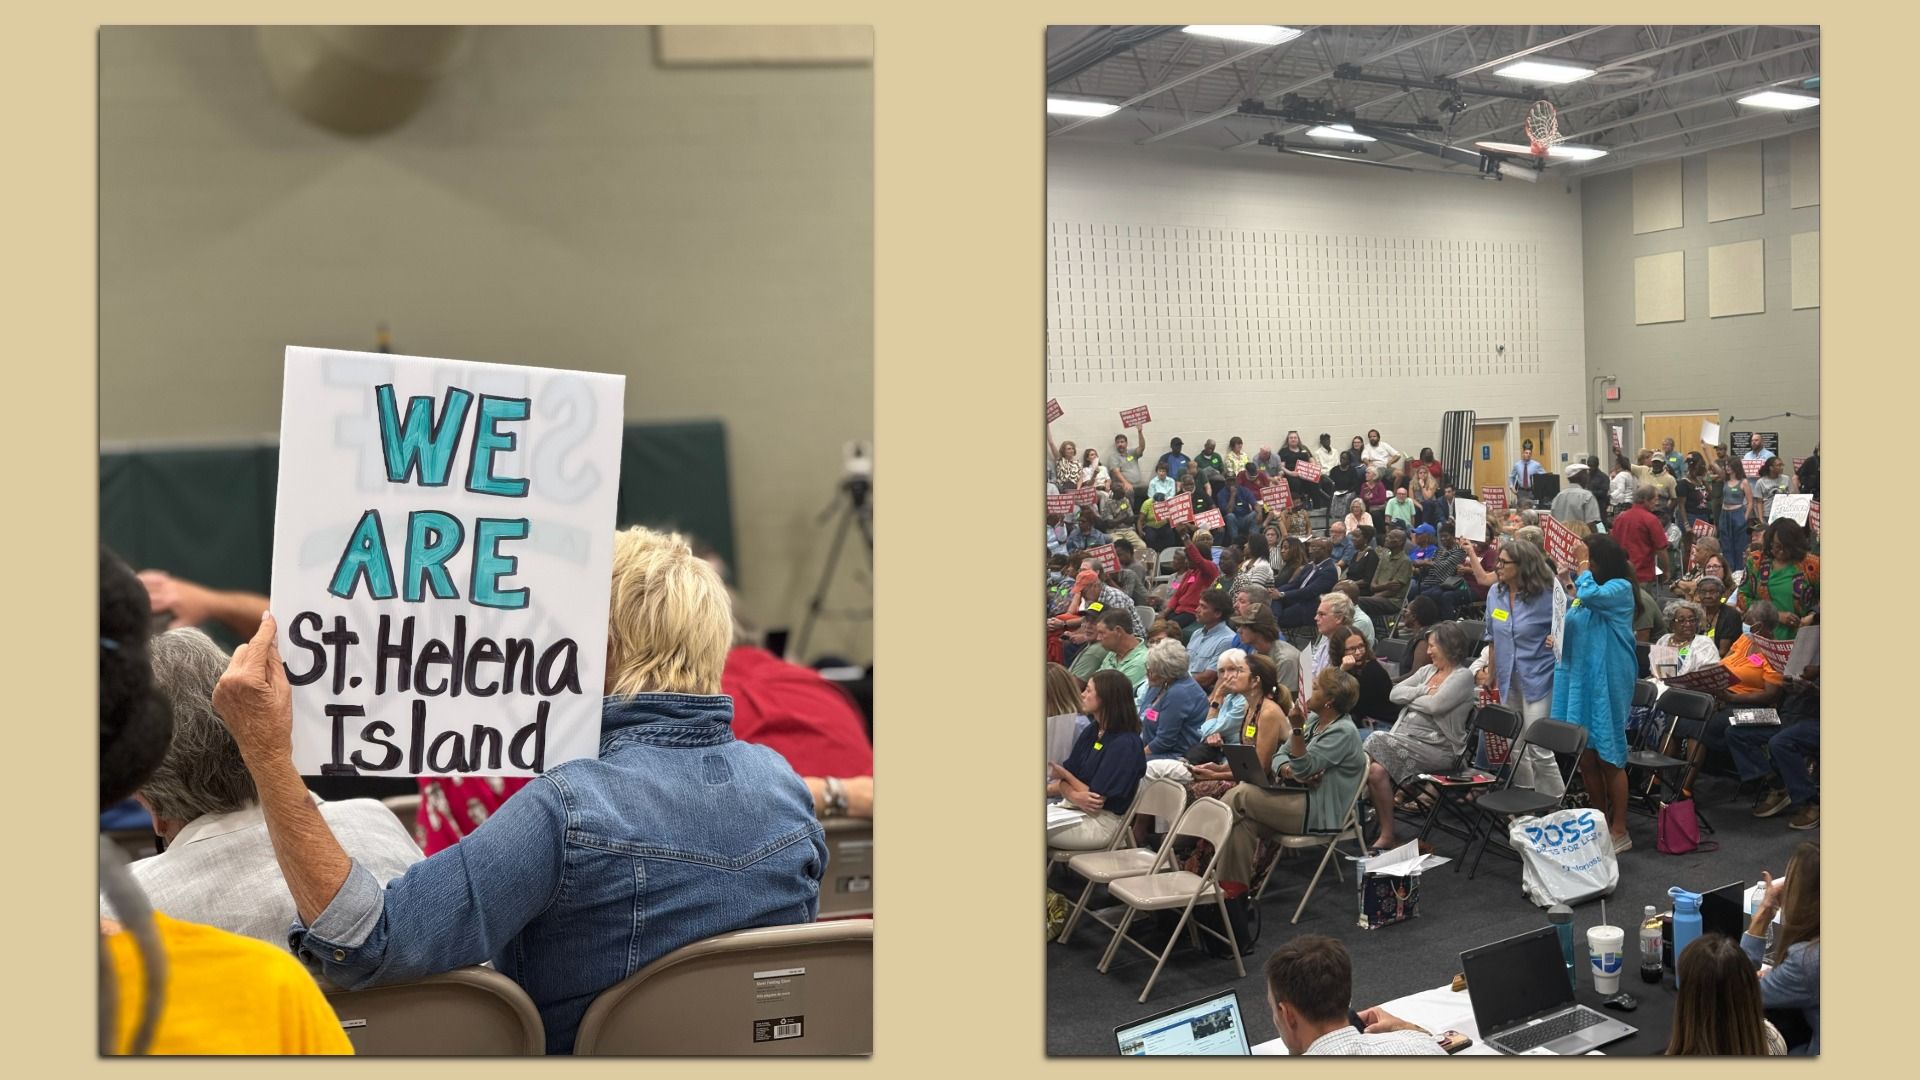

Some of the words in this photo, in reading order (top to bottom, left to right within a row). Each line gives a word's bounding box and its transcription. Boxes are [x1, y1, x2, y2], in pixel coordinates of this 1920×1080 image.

[375, 383, 531, 498] WE
[327, 509, 530, 609] ARE
[283, 611, 363, 695] St.
[375, 615, 583, 697] Helena
[320, 700, 551, 775] Island
[1562, 843, 1580, 854] FOR
